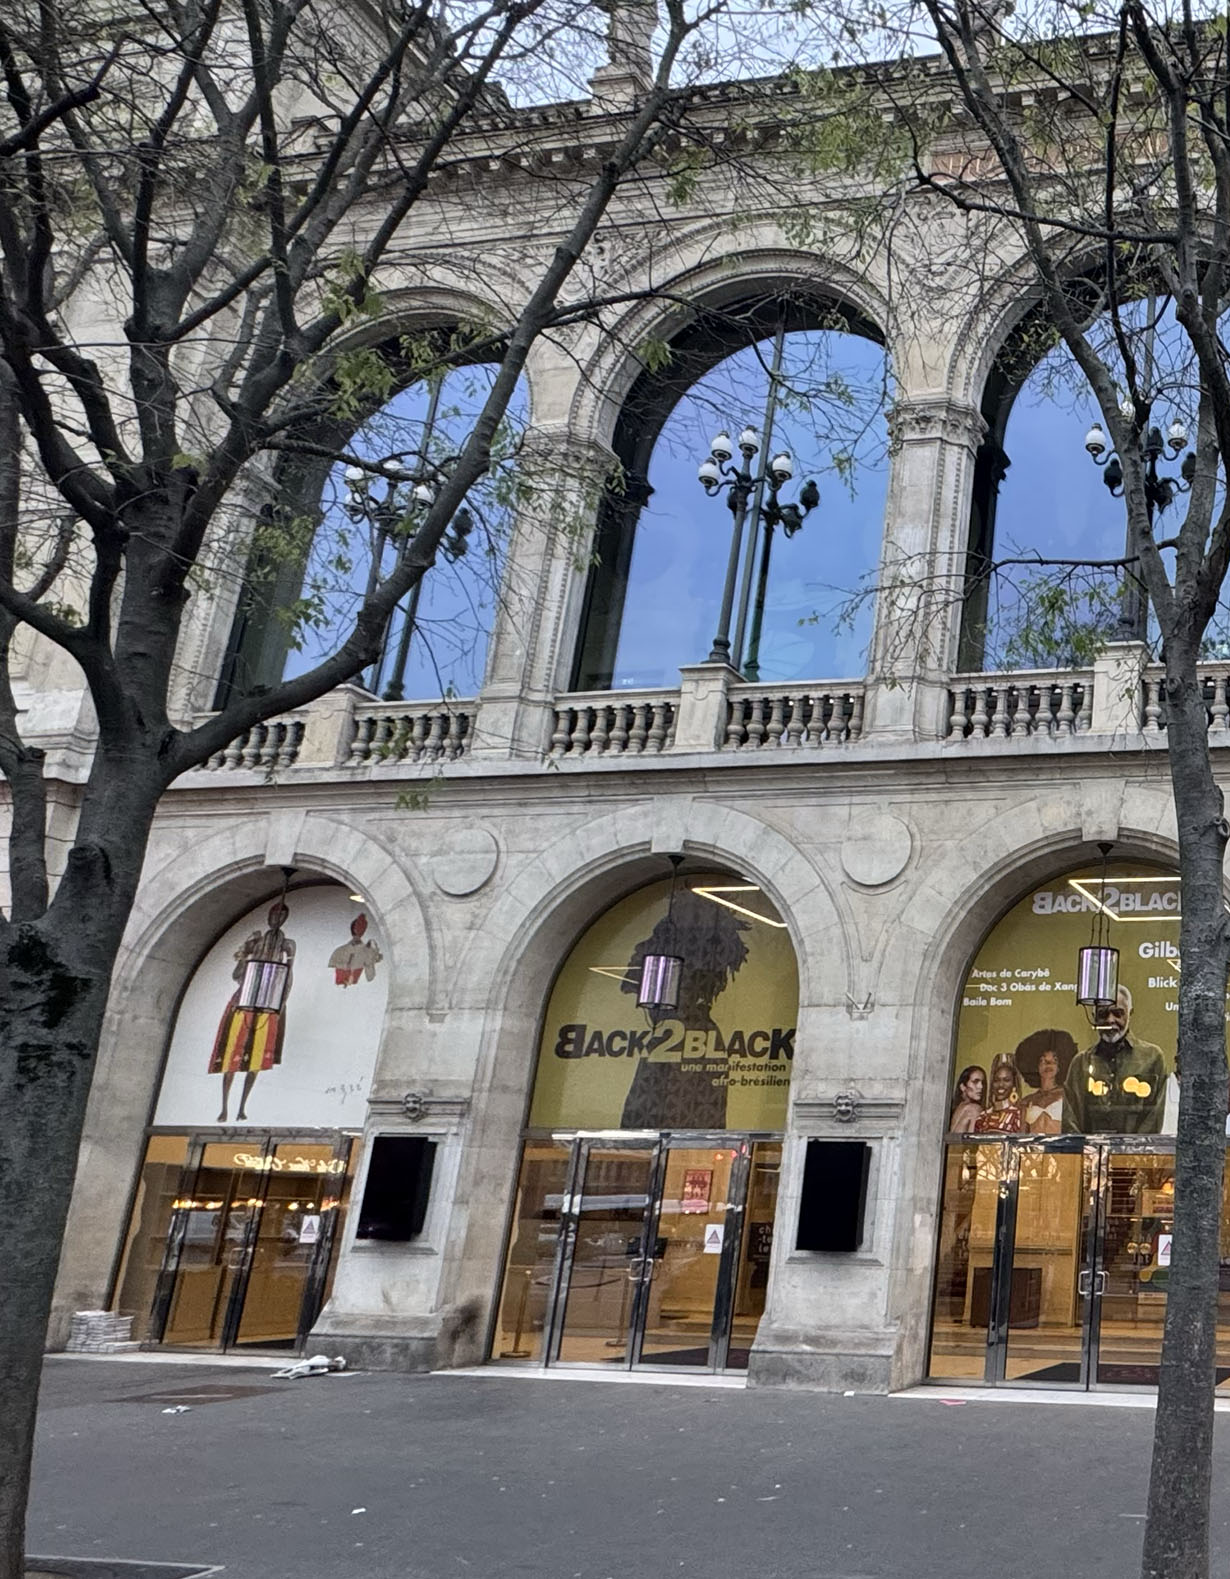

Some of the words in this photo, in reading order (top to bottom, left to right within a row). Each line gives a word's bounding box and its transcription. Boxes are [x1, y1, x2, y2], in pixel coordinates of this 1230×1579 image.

[999, 968, 1012, 978] de
[1000, 982, 1008, 992] 3
[1038, 981, 1052, 991] de
[1147, 977, 1178, 988] Blick
[554, 1019, 796, 1063] BACK2BLACK
[680, 1063, 703, 1072] une
[706, 1061, 786, 1072] manifestation
